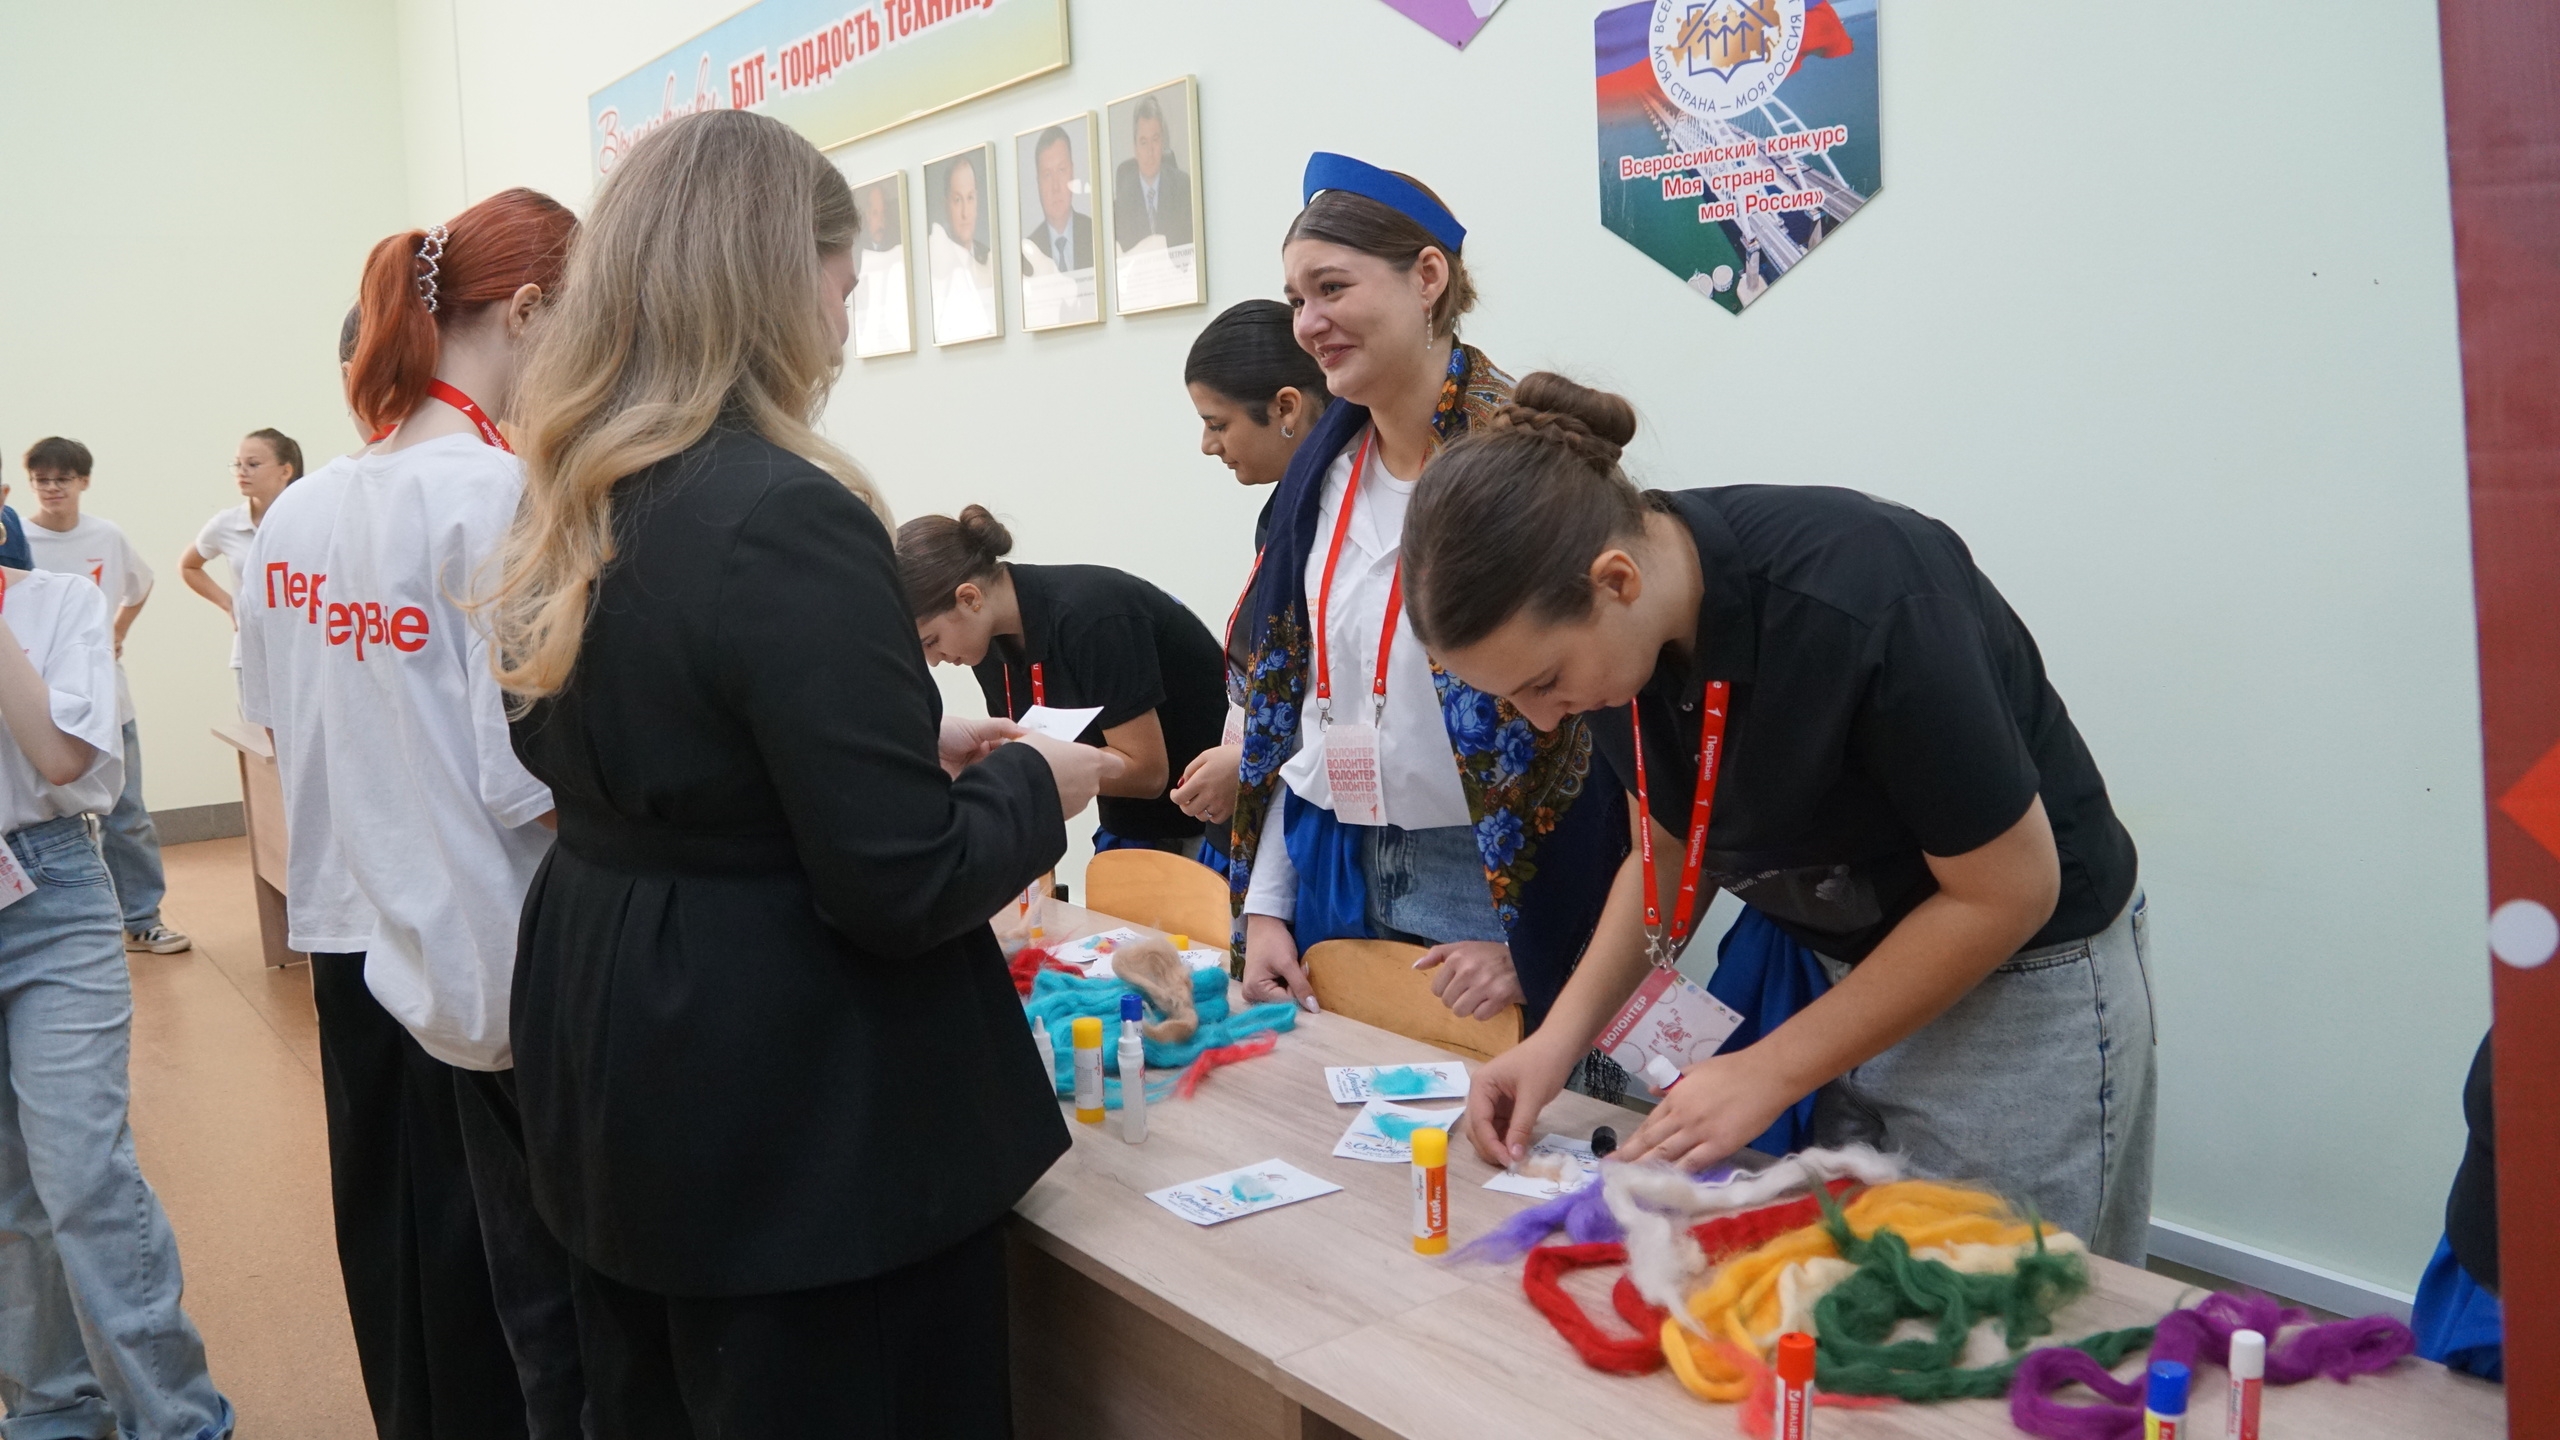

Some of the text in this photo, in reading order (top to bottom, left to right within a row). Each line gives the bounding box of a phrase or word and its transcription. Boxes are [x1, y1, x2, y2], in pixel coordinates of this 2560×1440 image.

[731, 54, 765, 110] БЛТ
[780, 9, 880, 91] гордость
[1654, 45, 1672, 84] МОЯ
[1670, 82, 1716, 113] СТРАНА
[1736, 82, 1767, 109] МОЯ
[1767, 14, 1801, 86] РОССИЯ
[1621, 127, 1845, 177] Всероссийский конкурс
[1664, 177, 1701, 197] Моя
[1711, 168, 1775, 192] страна
[1701, 189, 1823, 220] моя Россия»
[266, 561, 327, 624] Пер
[1327, 759, 1375, 769] ВОЛОНТЕР
[1328, 770, 1376, 780] ВОЛОНТЕР
[1703, 735, 1718, 781] Первые
[1330, 781, 1377, 792] ВОЛОНТЕР
[1642, 816, 1651, 862] Первые
[1689, 824, 1704, 868] Первые
[1601, 995, 1648, 1048] ВОЛОНТЕР
[1430, 1199, 1442, 1228] КЛЕЙ
[1789, 1401, 1799, 1440] BRAUBE
